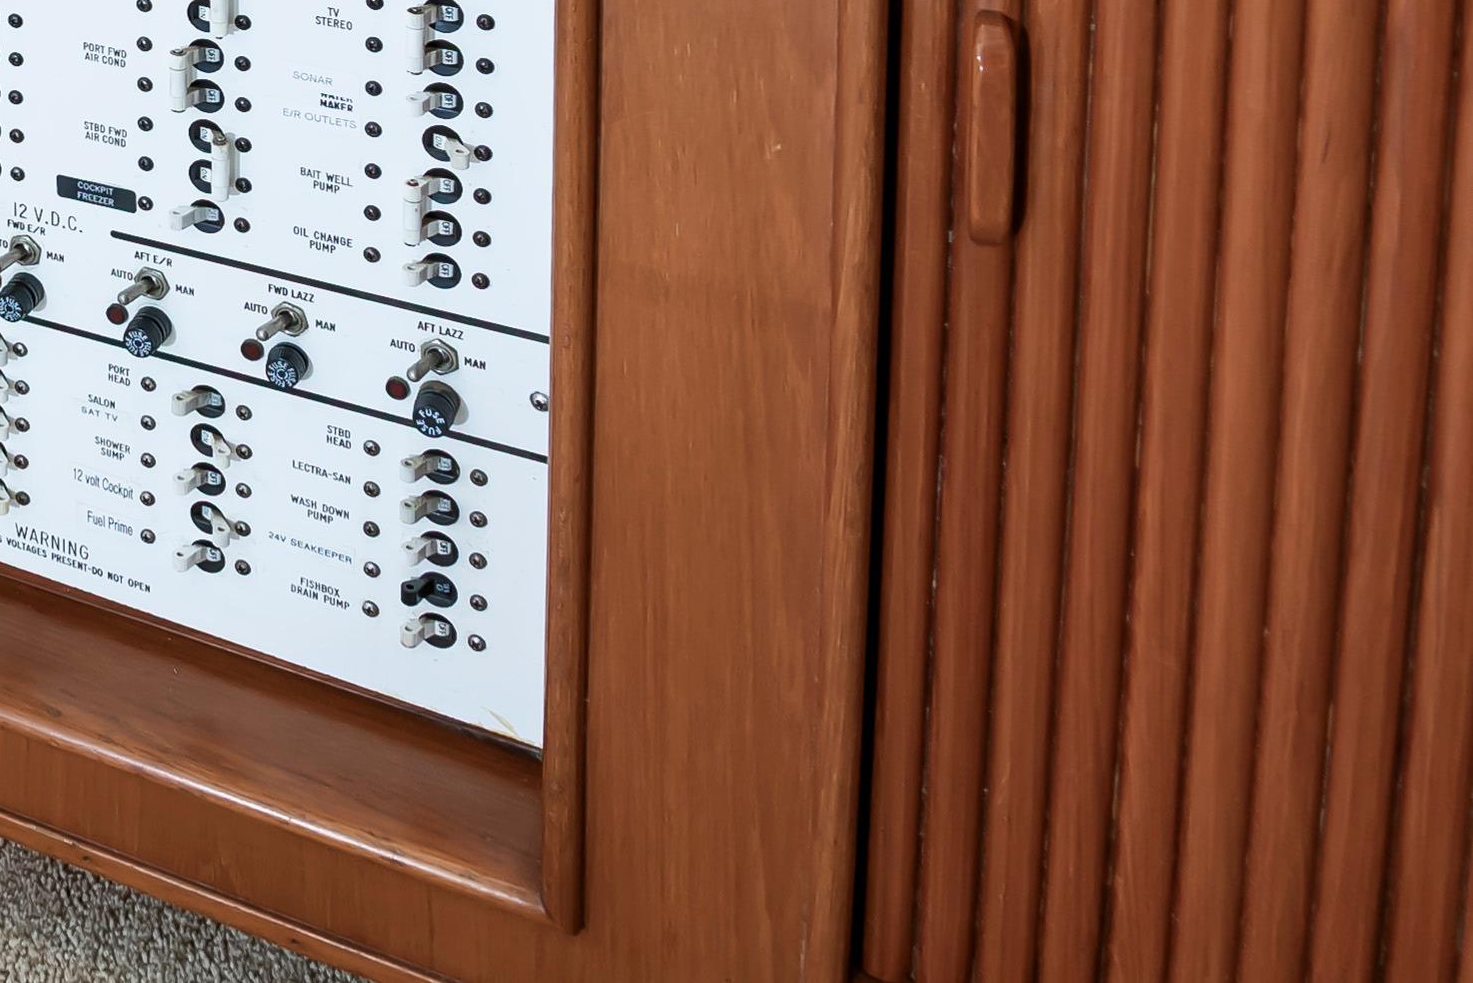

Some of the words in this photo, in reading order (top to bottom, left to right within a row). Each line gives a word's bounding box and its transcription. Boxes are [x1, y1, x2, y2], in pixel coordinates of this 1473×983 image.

[327, 7, 339, 17] TV
[315, 16, 353, 30] STEREO
[83, 42, 104, 53] PORT
[108, 48, 126, 58] FWD
[85, 53, 99, 62] AIR
[102, 56, 126, 68] COND
[293, 71, 333, 86] SONAR
[84, 121, 105, 133] STBD
[109, 127, 127, 138] FWD
[85, 132, 99, 142] AIR
[102, 135, 126, 147] COND
[300, 167, 320, 179] BAIT
[326, 172, 353, 186] WELL
[77, 181, 113, 196] COCKPIT
[313, 180, 340, 194] PUMP
[77, 192, 114, 206] FREEZER
[14, 202, 27, 218] 12
[34, 207, 83, 233] V.D.C.
[7, 220, 25, 230] FWD
[27, 224, 46, 235] E/R
[293, 226, 309, 238] OIL
[314, 231, 353, 248] CHANGE
[310, 240, 336, 254] PUMP
[47, 251, 65, 262] MAN
[134, 251, 150, 262] AFT
[153, 255, 172, 267] E/R
[111, 269, 133, 281] AUTO
[176, 285, 195, 296] MAN
[268, 284, 288, 296] FWD
[291, 290, 315, 303] LAZZ
[244, 302, 268, 314] AUTO
[315, 320, 336, 331] MAN
[418, 321, 435, 333] AFT
[439, 326, 464, 340] LAZZ
[390, 339, 415, 352] AUTO
[108, 364, 130, 377] PORT
[464, 357, 486, 369] MAN
[108, 374, 130, 387] HEAD
[88, 394, 115, 409] SALON
[327, 425, 351, 439] STBD
[95, 436, 131, 454] SHOWER
[326, 435, 351, 449] HEAD
[101, 448, 125, 462] SUMP
[292, 460, 351, 485] LECTRA-SAN
[73, 468, 82, 481] 12
[85, 472, 100, 488] volt
[102, 478, 134, 500] Cockpit
[291, 494, 317, 510] WASH
[323, 504, 349, 519] DOWN
[87, 510, 105, 525] Fuel
[108, 517, 133, 536] Prime
[307, 510, 333, 524] PUMP
[15, 522, 89, 560] WARNING
[268, 531, 286, 543] 24V
[291, 538, 352, 565] SEAKEEPER
[7, 538, 47, 558] VOLTAGES
[51, 552, 103, 577] PRESENT-DO
[107, 572, 123, 584] NOT
[128, 578, 151, 593] OPEN
[300, 577, 340, 598] FISHBOX
[291, 584, 318, 601] DRAIN
[323, 595, 350, 611] PUMP
